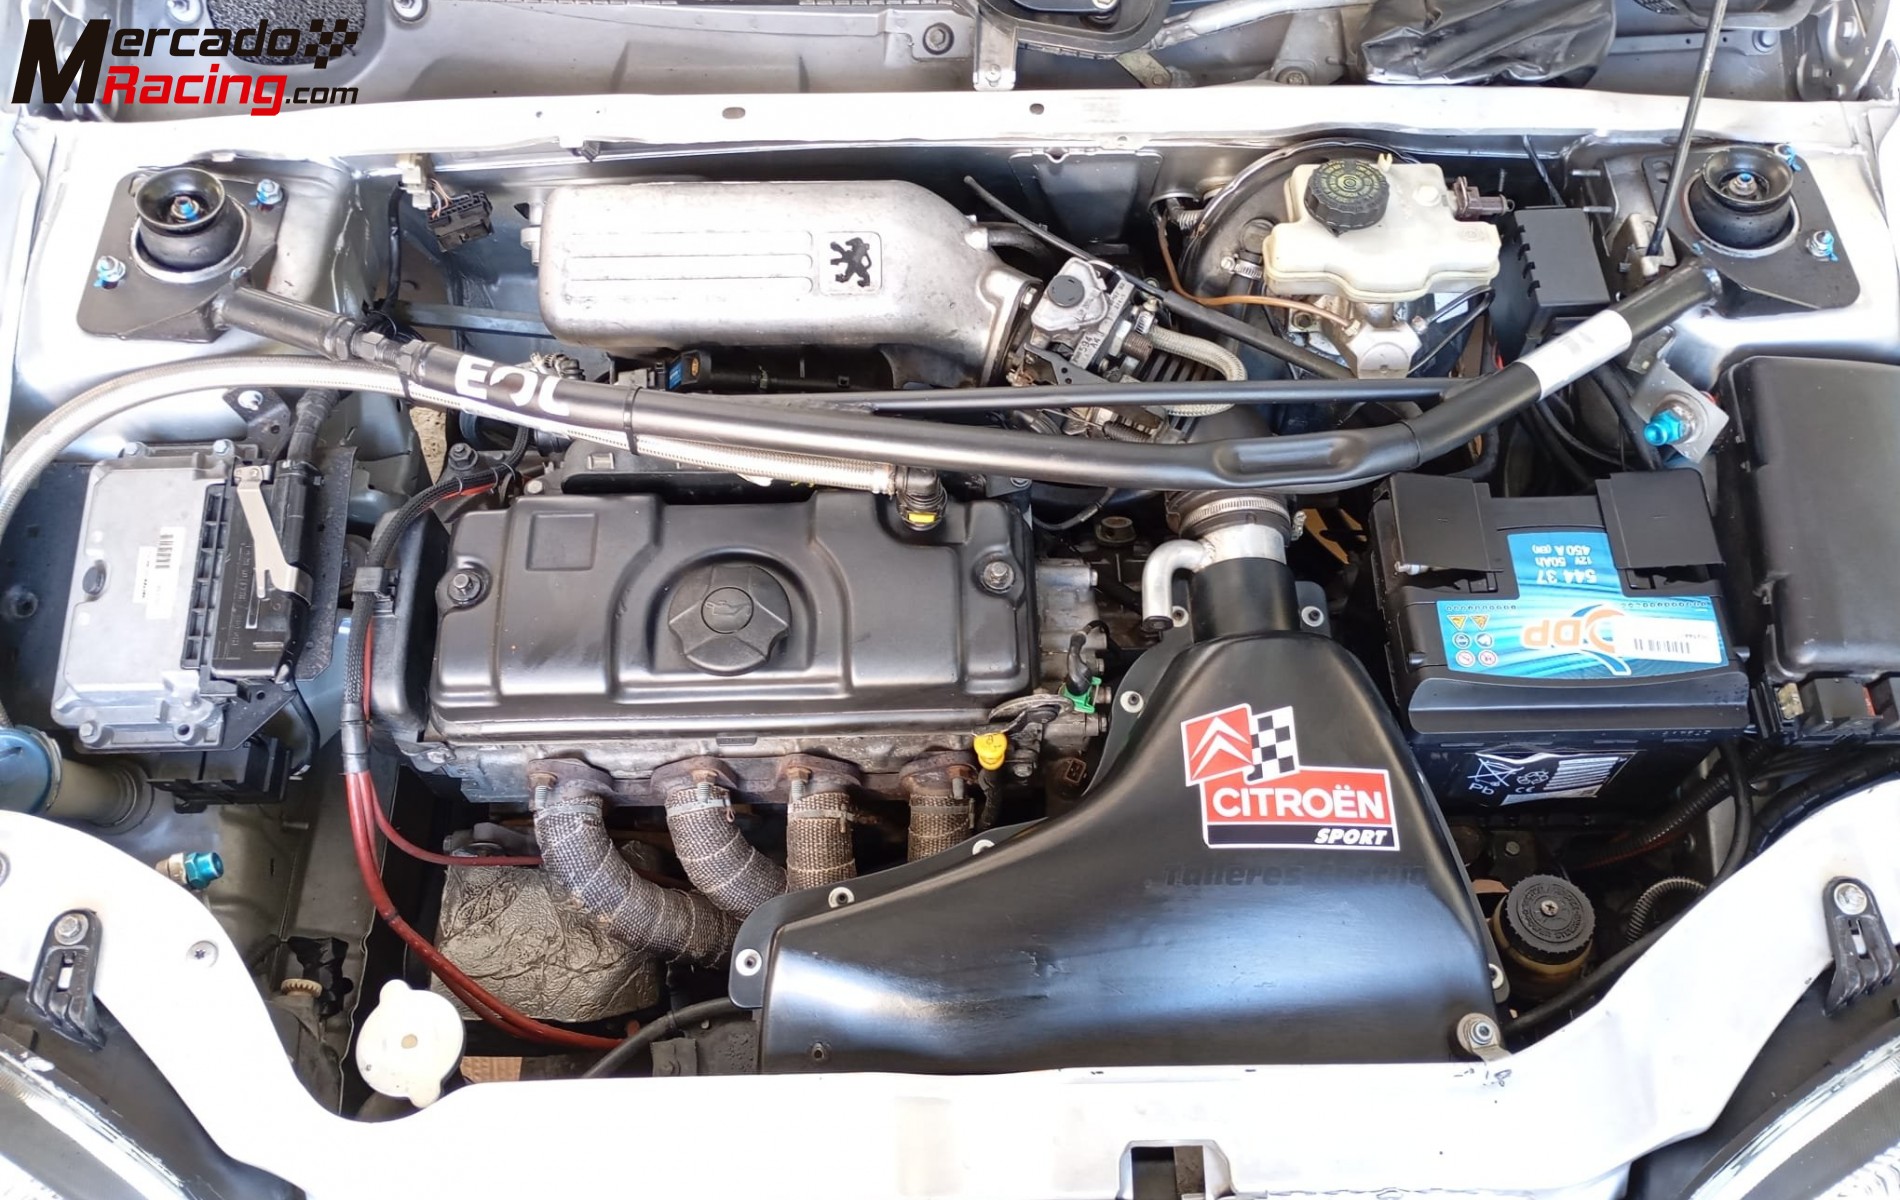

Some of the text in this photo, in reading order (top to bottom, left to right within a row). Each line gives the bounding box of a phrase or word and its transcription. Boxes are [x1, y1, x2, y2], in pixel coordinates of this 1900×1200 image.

[1468, 782, 1496, 797] Pb
[1212, 784, 1386, 820] CITROËN
[1314, 828, 1388, 846] SPORT
